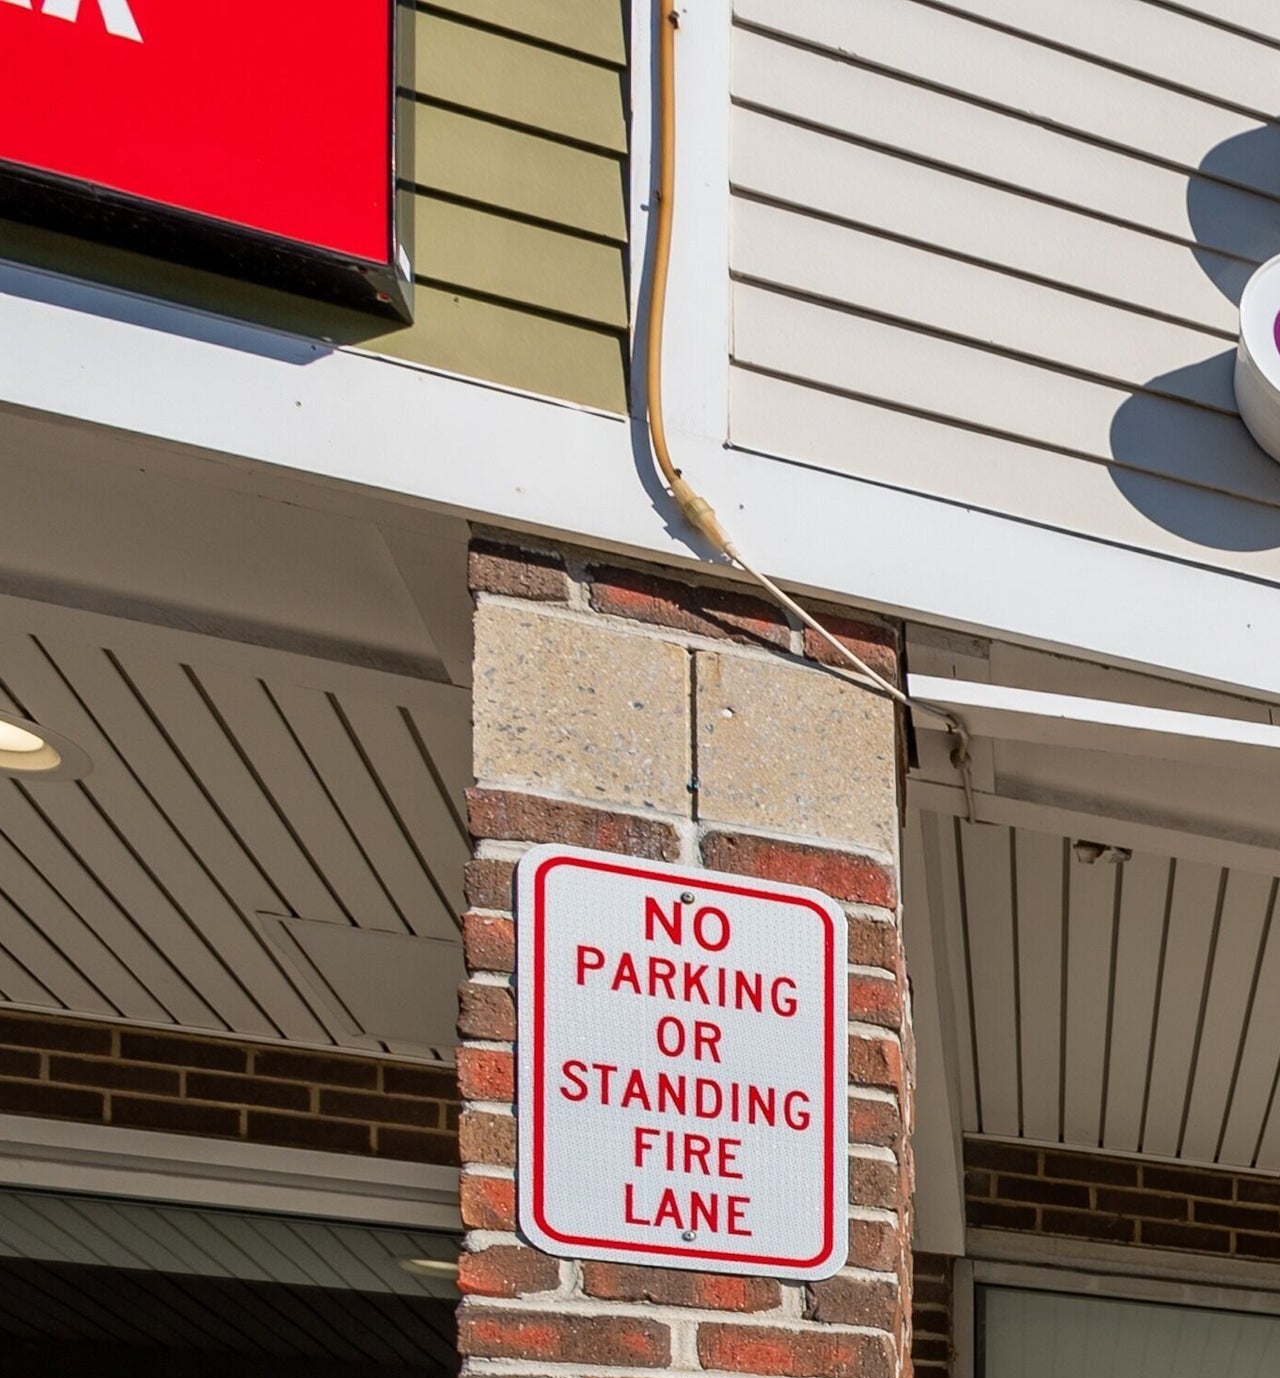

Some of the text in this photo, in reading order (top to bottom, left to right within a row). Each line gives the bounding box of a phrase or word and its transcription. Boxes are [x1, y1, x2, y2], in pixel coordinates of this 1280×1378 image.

[644, 896, 731, 952] NO
[575, 945, 799, 1018] PARKING
[656, 1015, 722, 1064] OR
[559, 1059, 812, 1132] STANDING
[633, 1126, 745, 1180] FIRE
[624, 1183, 753, 1237] LANE
